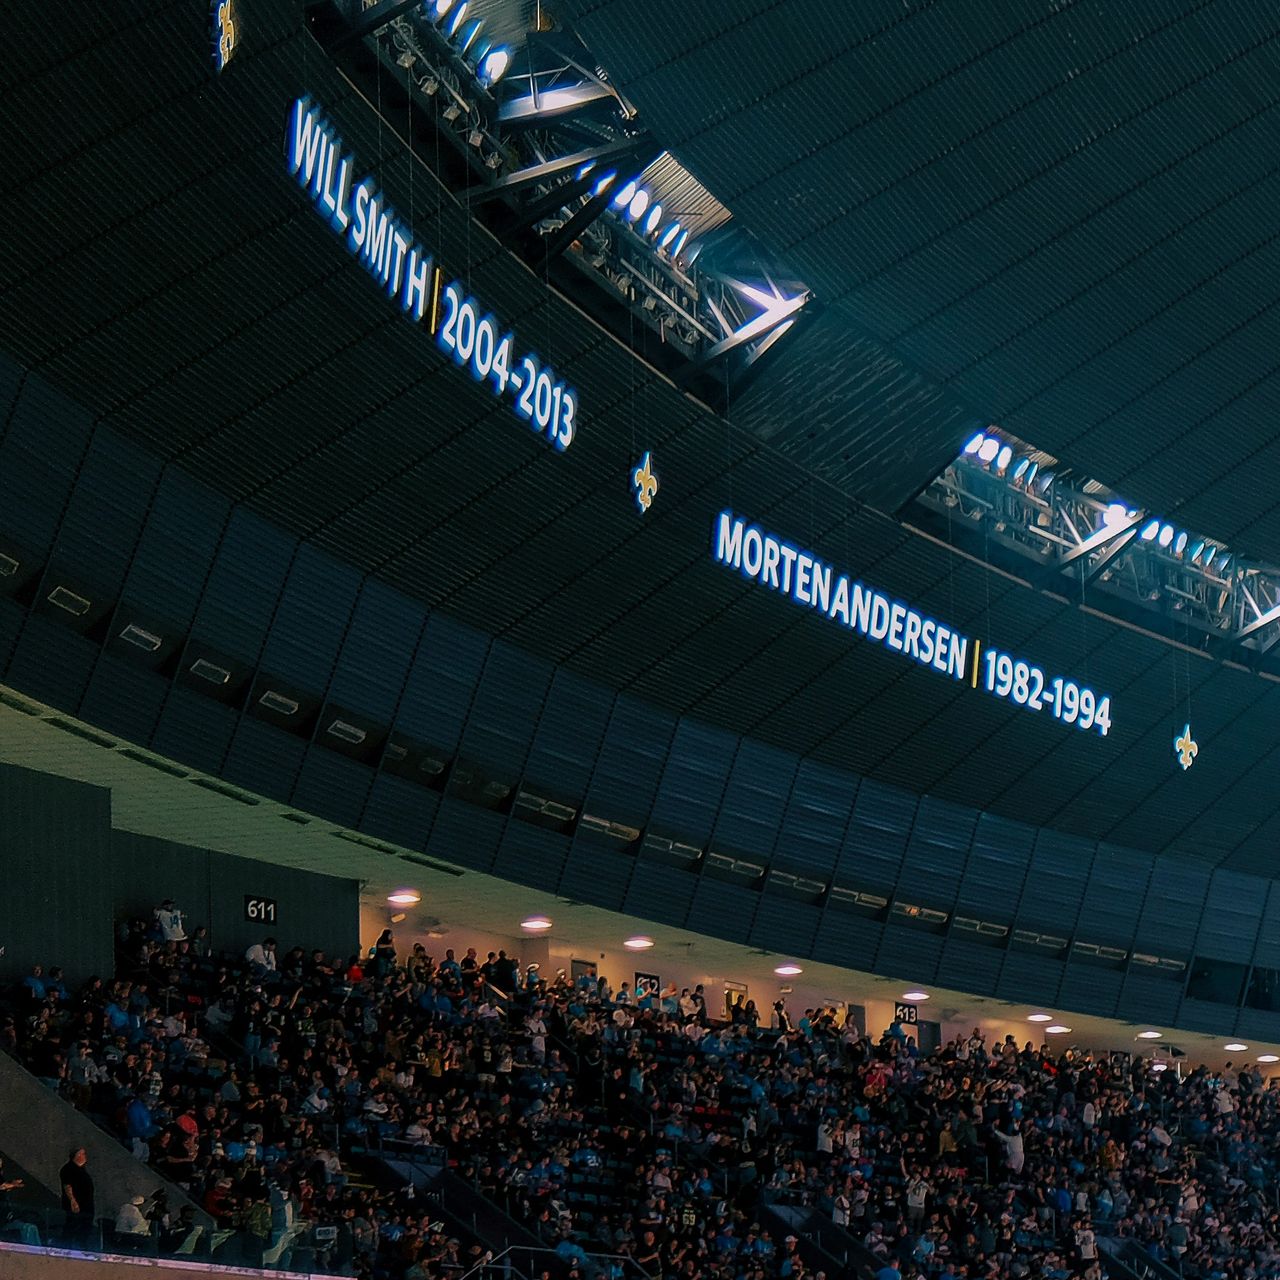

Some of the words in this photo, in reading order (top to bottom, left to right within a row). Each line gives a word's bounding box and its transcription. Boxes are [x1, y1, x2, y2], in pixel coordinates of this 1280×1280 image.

[292, 98, 351, 231] WILL
[350, 184, 431, 322] SMITH
[441, 286, 577, 449] 2004-2013
[716, 512, 832, 612] MORTEN
[830, 578, 968, 680] ANDERSEN
[985, 650, 1112, 736] 1982-1994
[247, 900, 275, 921] 611
[637, 976, 659, 996] 62
[896, 1004, 917, 1023] 613
